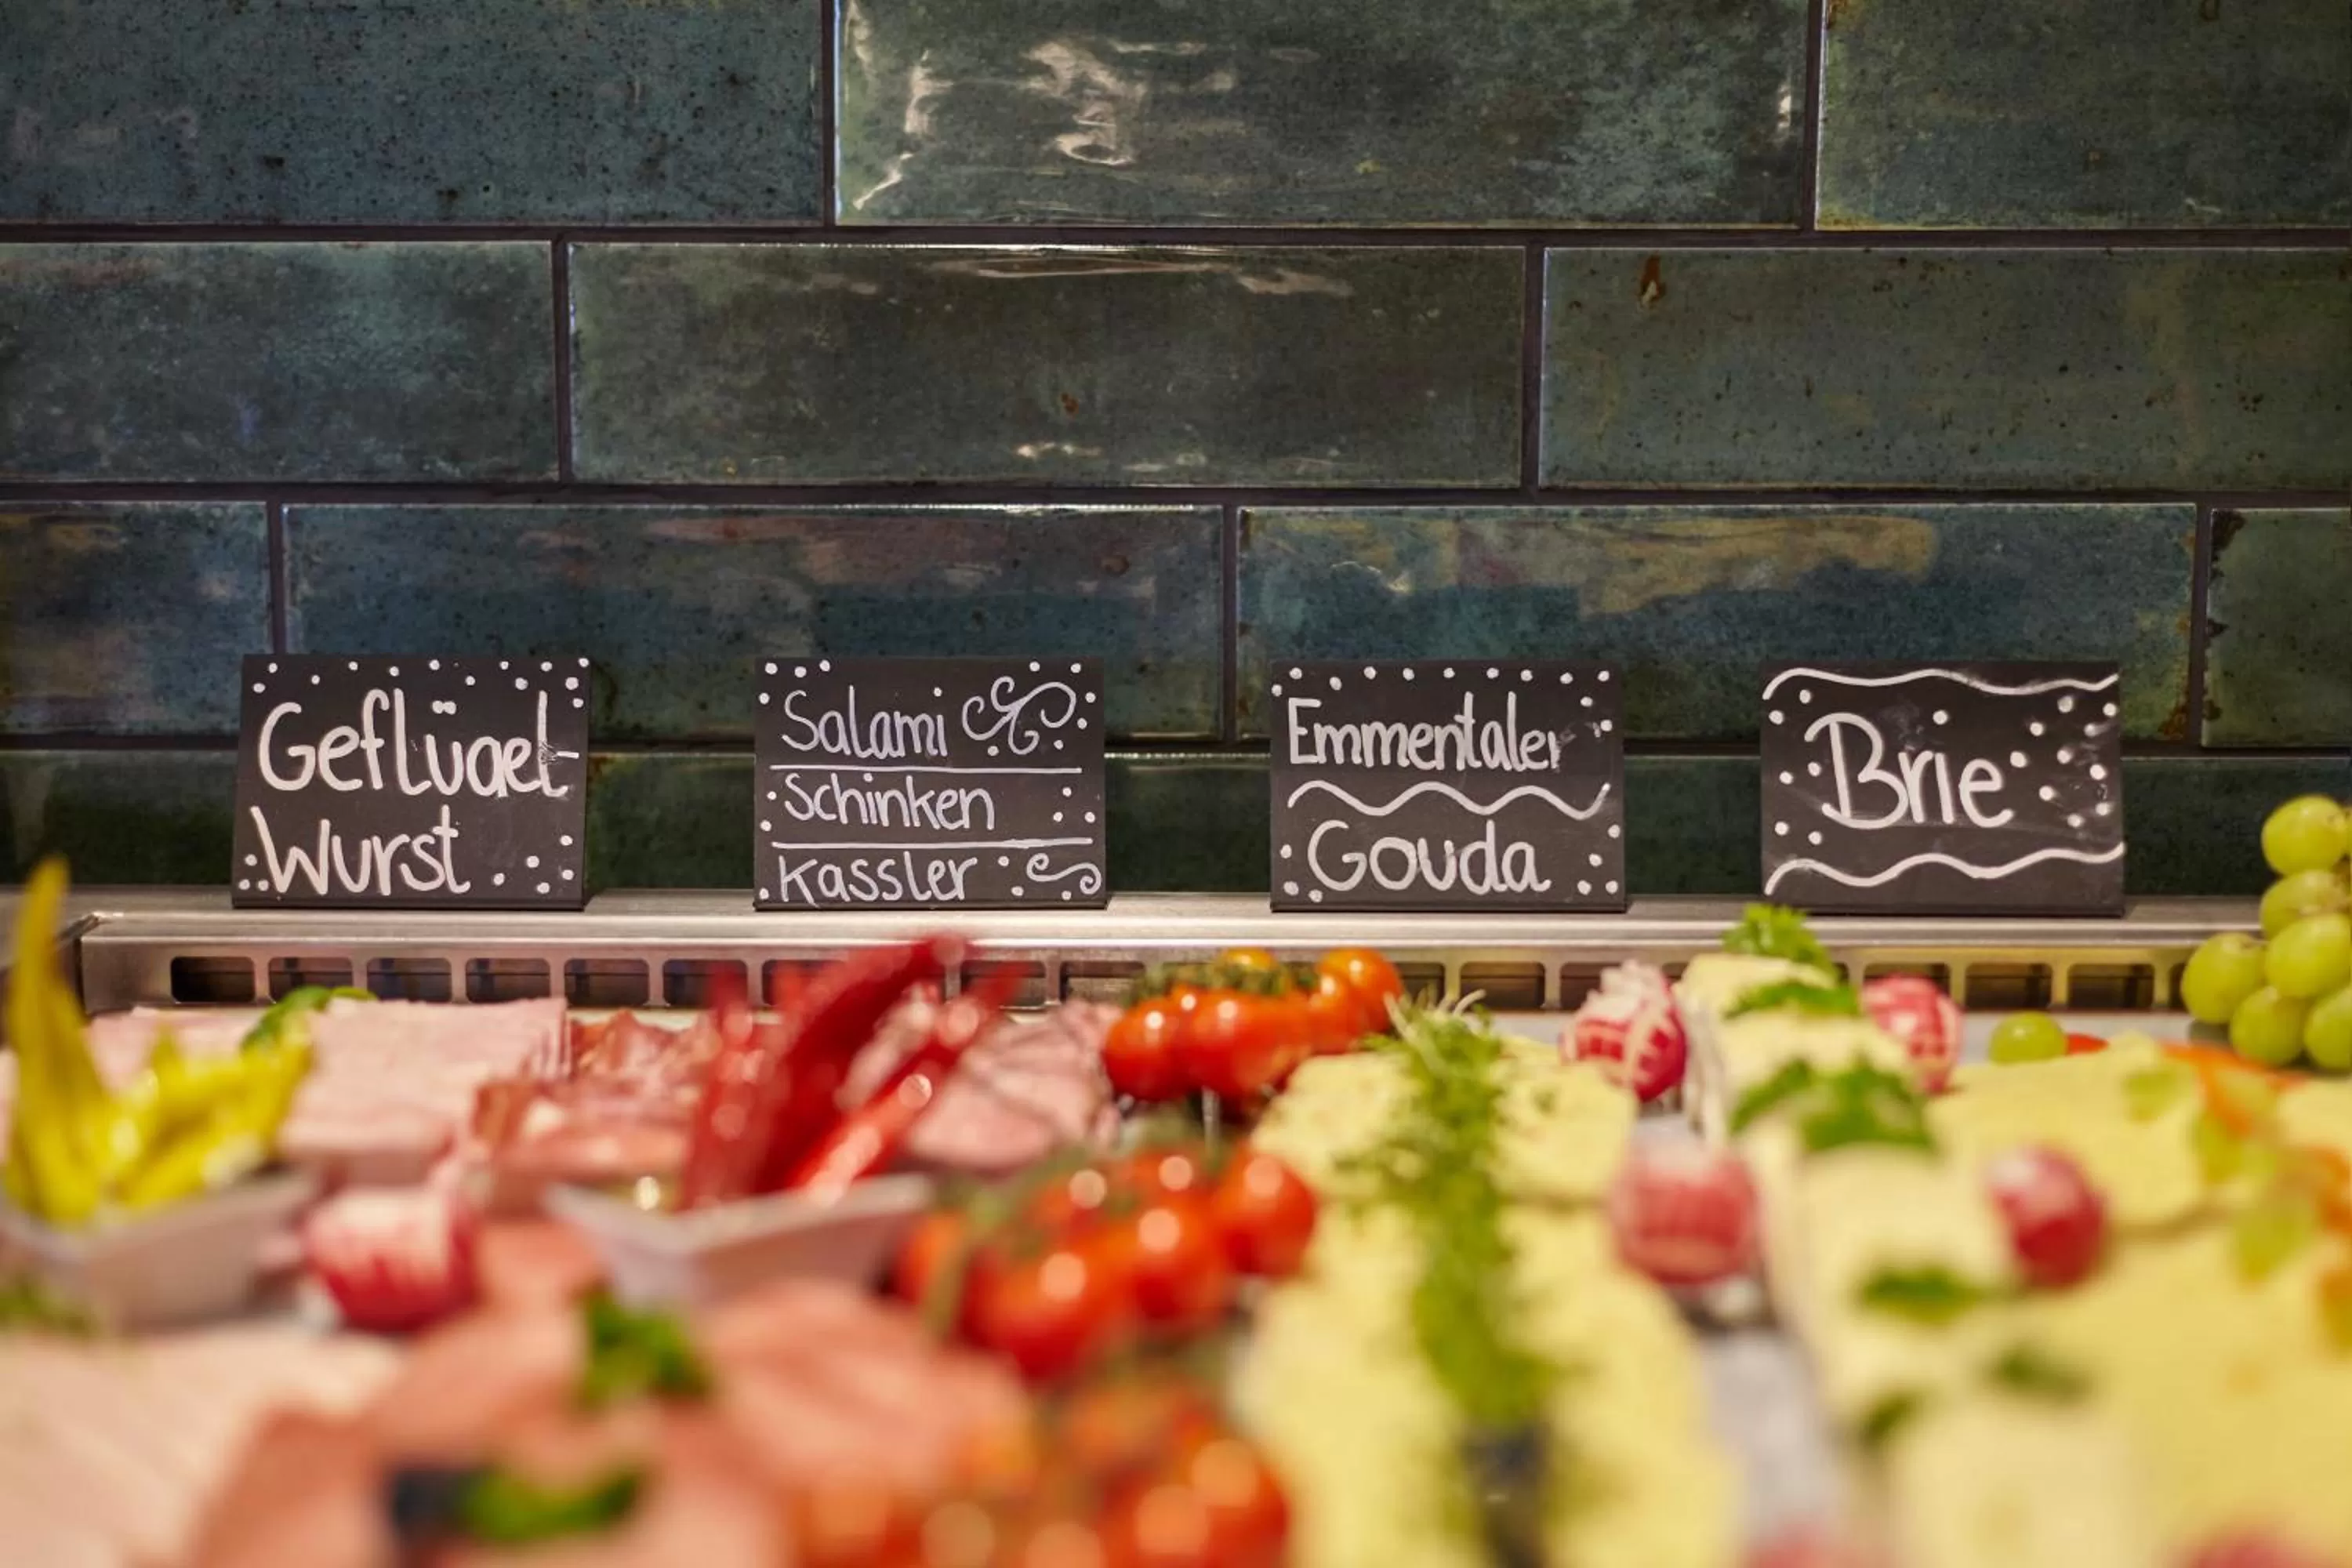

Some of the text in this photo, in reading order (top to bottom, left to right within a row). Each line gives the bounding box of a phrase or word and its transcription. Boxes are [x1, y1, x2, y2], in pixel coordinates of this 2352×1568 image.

[782, 684, 948, 760] Salami
[1288, 691, 1566, 771] Emmentaler
[785, 772, 994, 830] Schinken
[1804, 713, 2013, 829] Brie
[251, 804, 470, 896] Wurst
[779, 851, 978, 907] Kassler
[1308, 819, 1552, 895] Gouda
